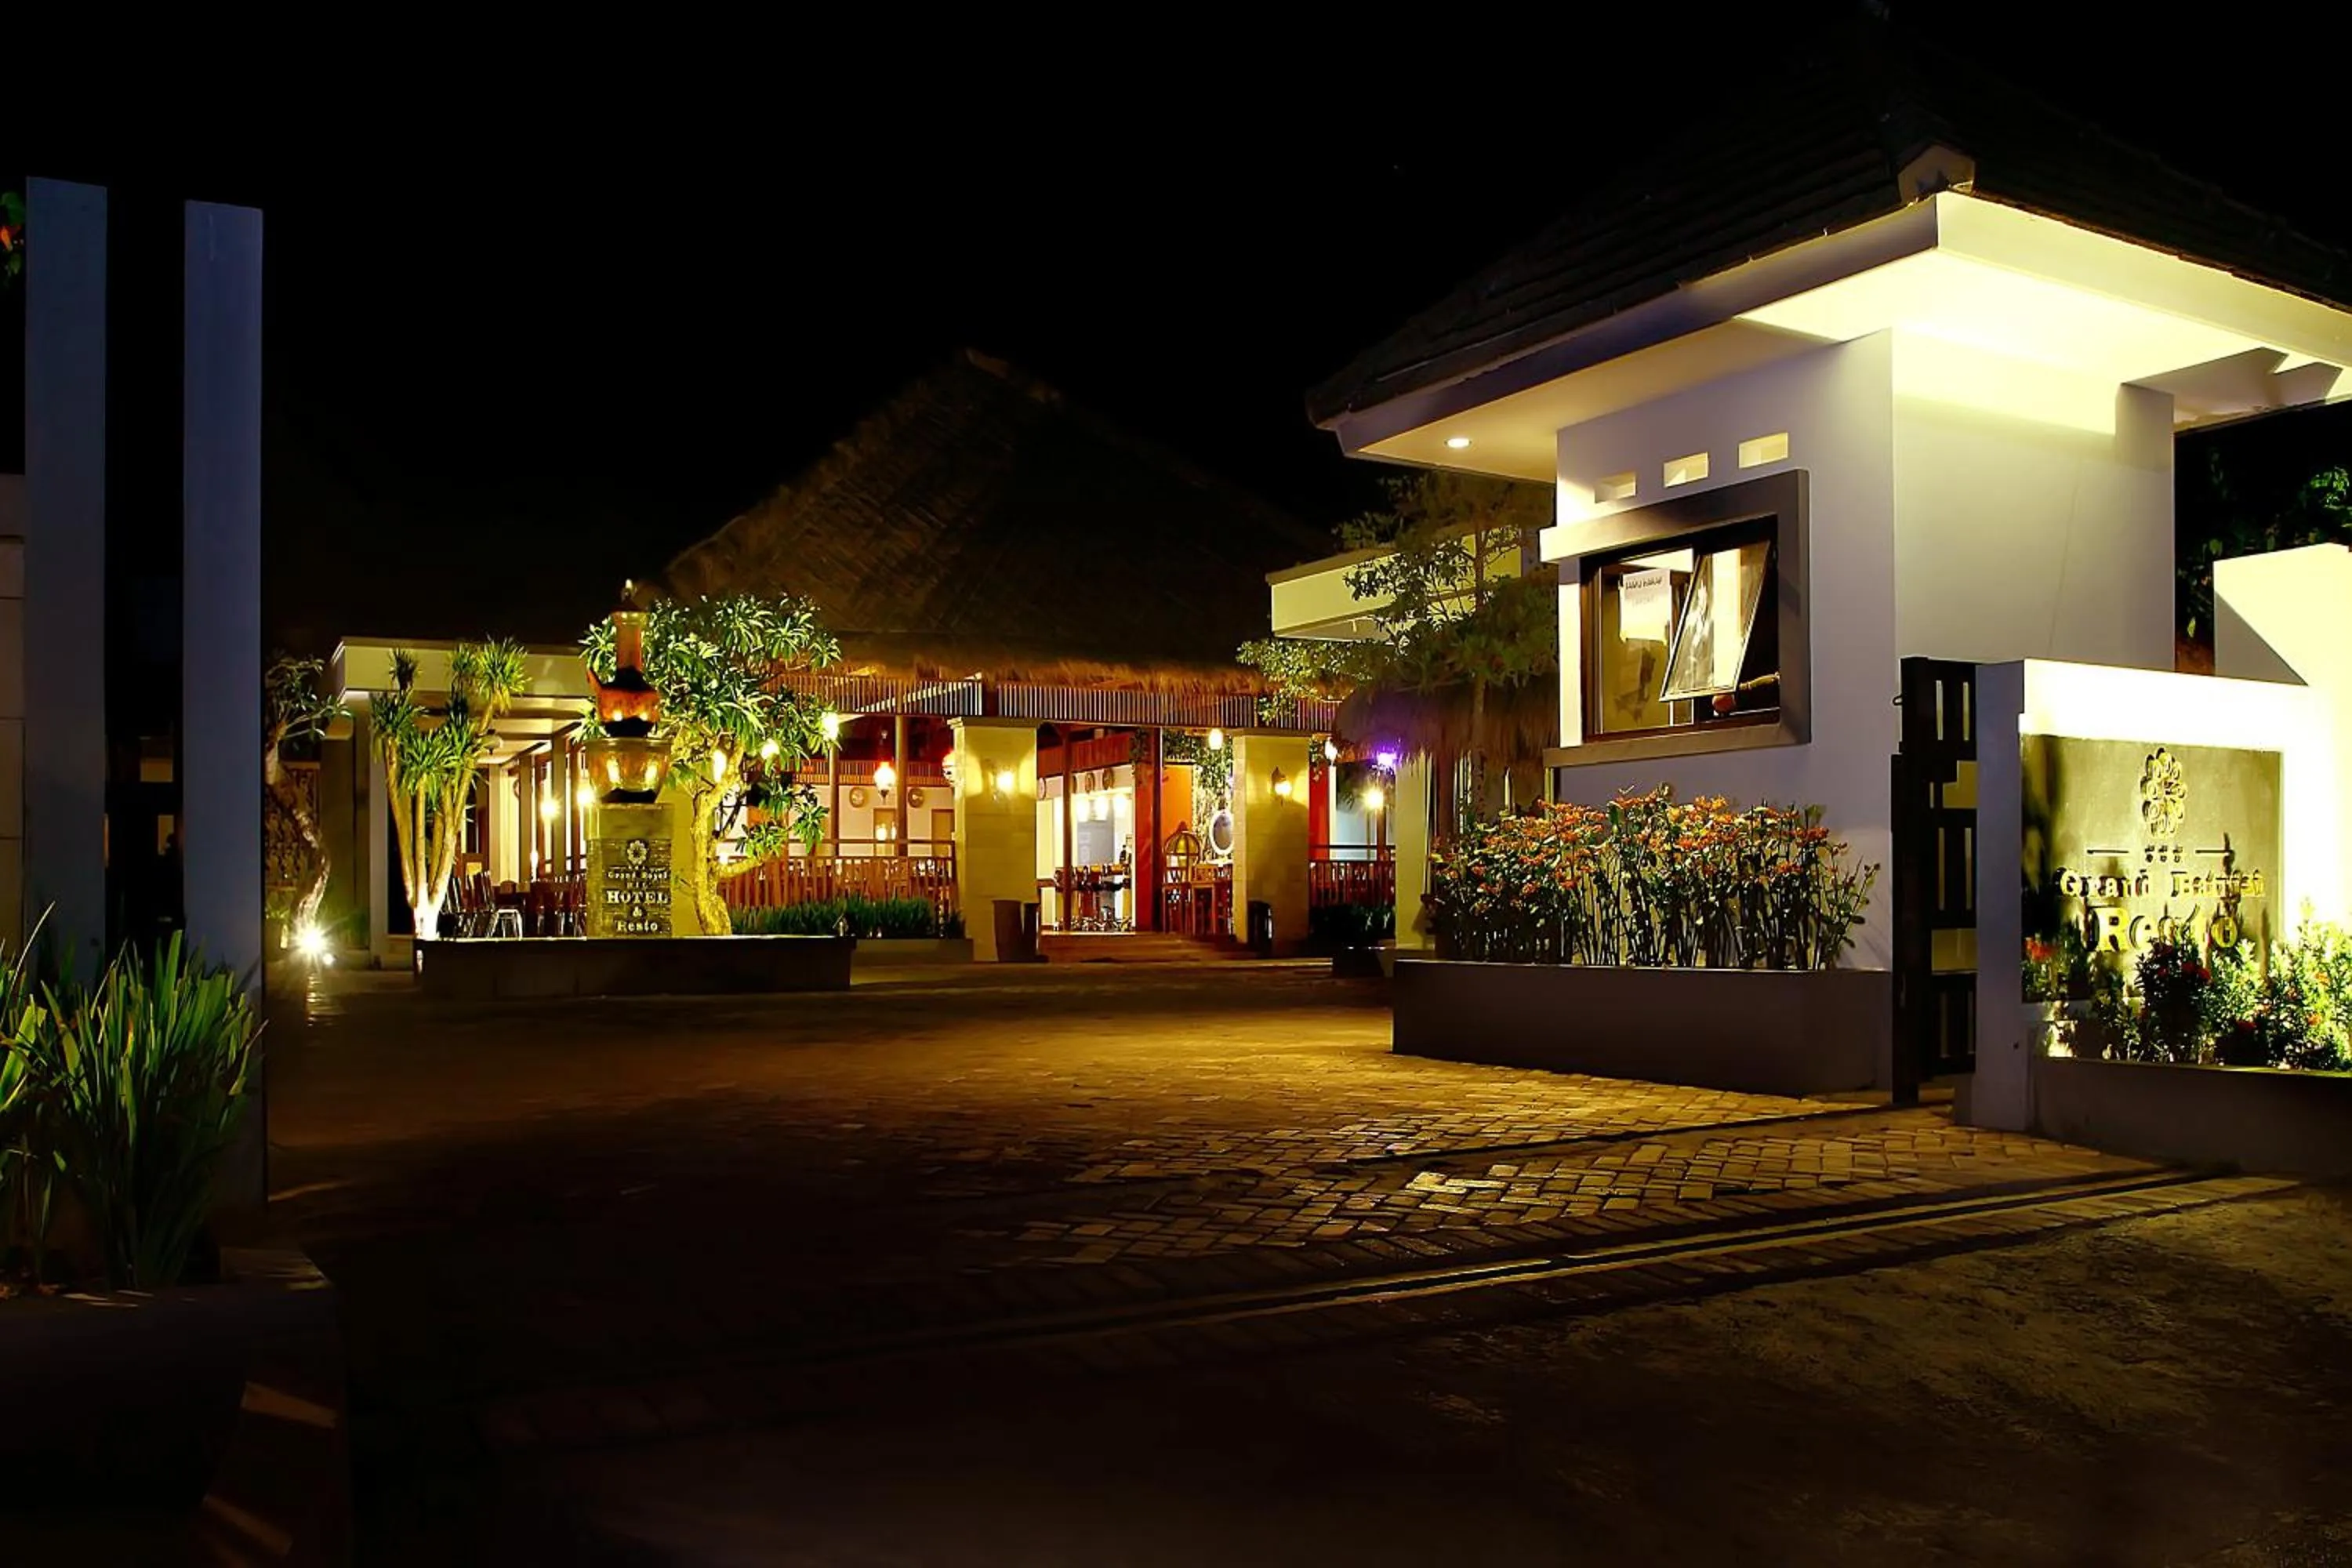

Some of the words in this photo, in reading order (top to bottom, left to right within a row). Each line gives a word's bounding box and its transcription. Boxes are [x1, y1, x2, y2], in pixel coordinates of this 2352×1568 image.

[2058, 869, 2149, 898] Grand
[607, 890, 668, 903] HOTEL
[633, 906, 642, 916] &
[615, 920, 658, 931] Resto
